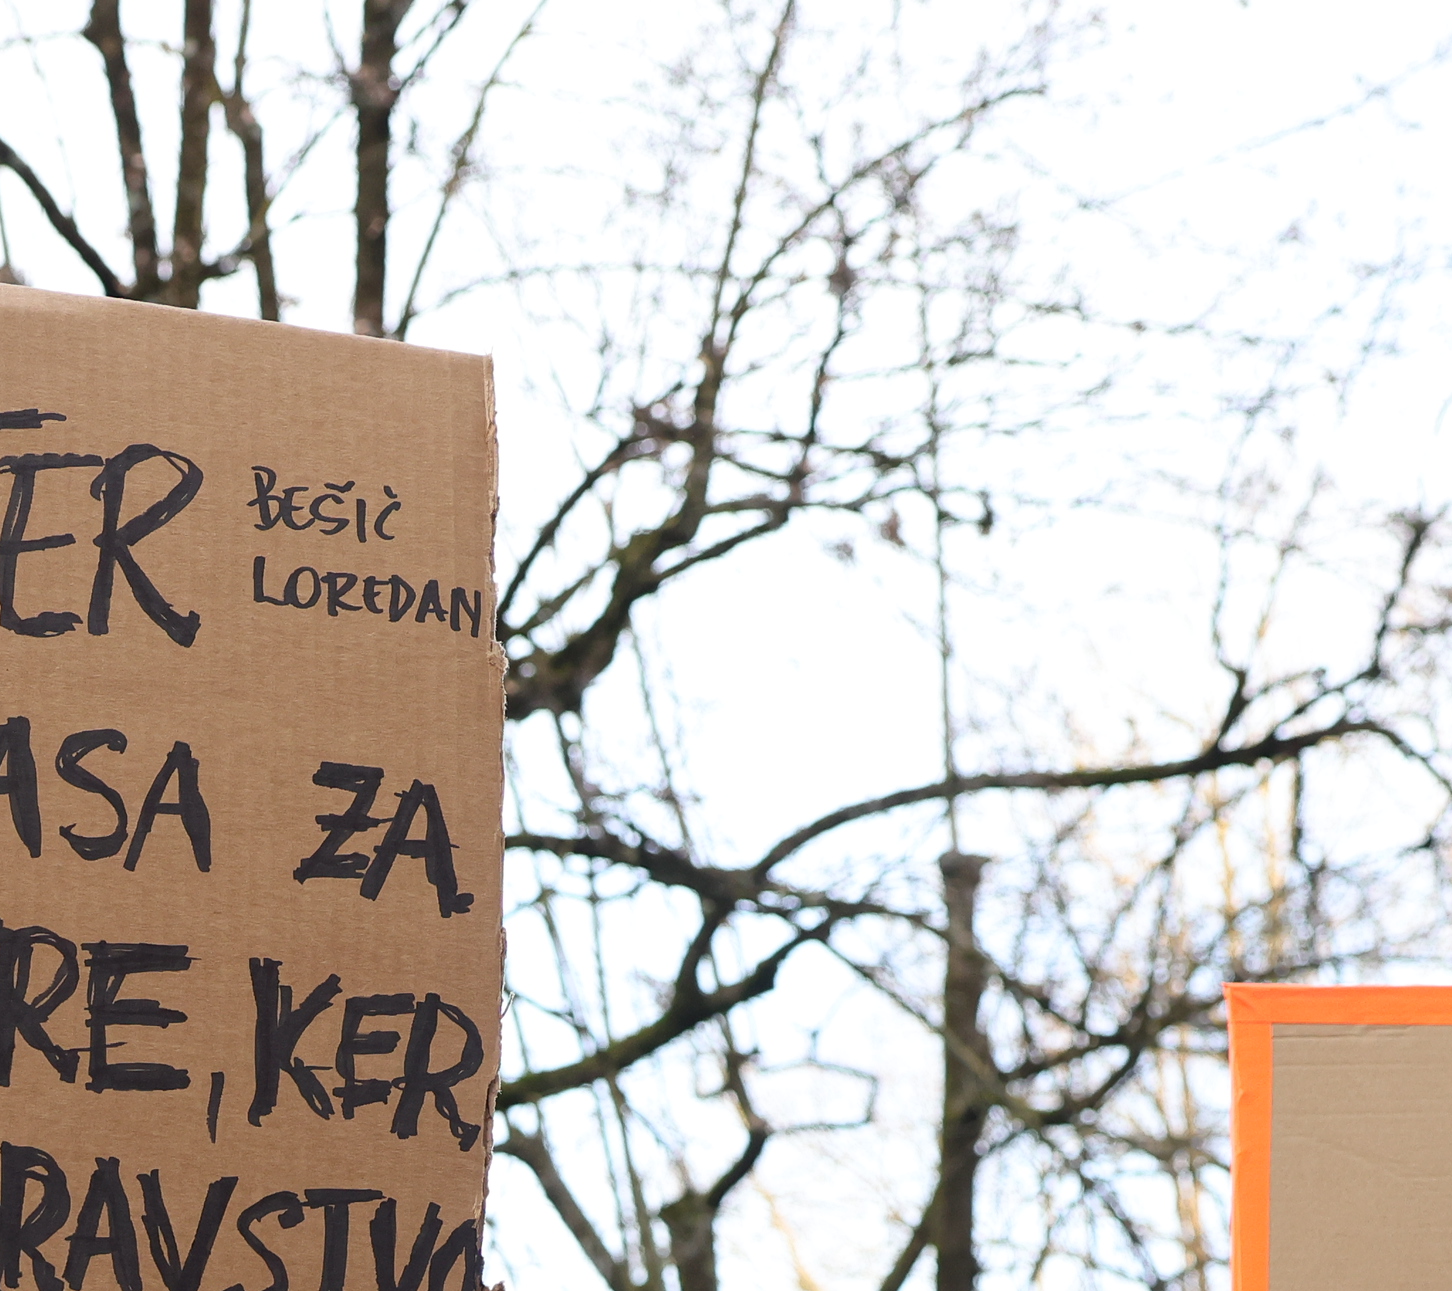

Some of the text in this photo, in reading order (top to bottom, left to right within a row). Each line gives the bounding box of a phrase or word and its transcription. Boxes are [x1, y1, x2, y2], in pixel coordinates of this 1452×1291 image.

[253, 555, 481, 638] LOREDAN
[292, 761, 474, 918] ZA
[245, 955, 480, 1153] KER
